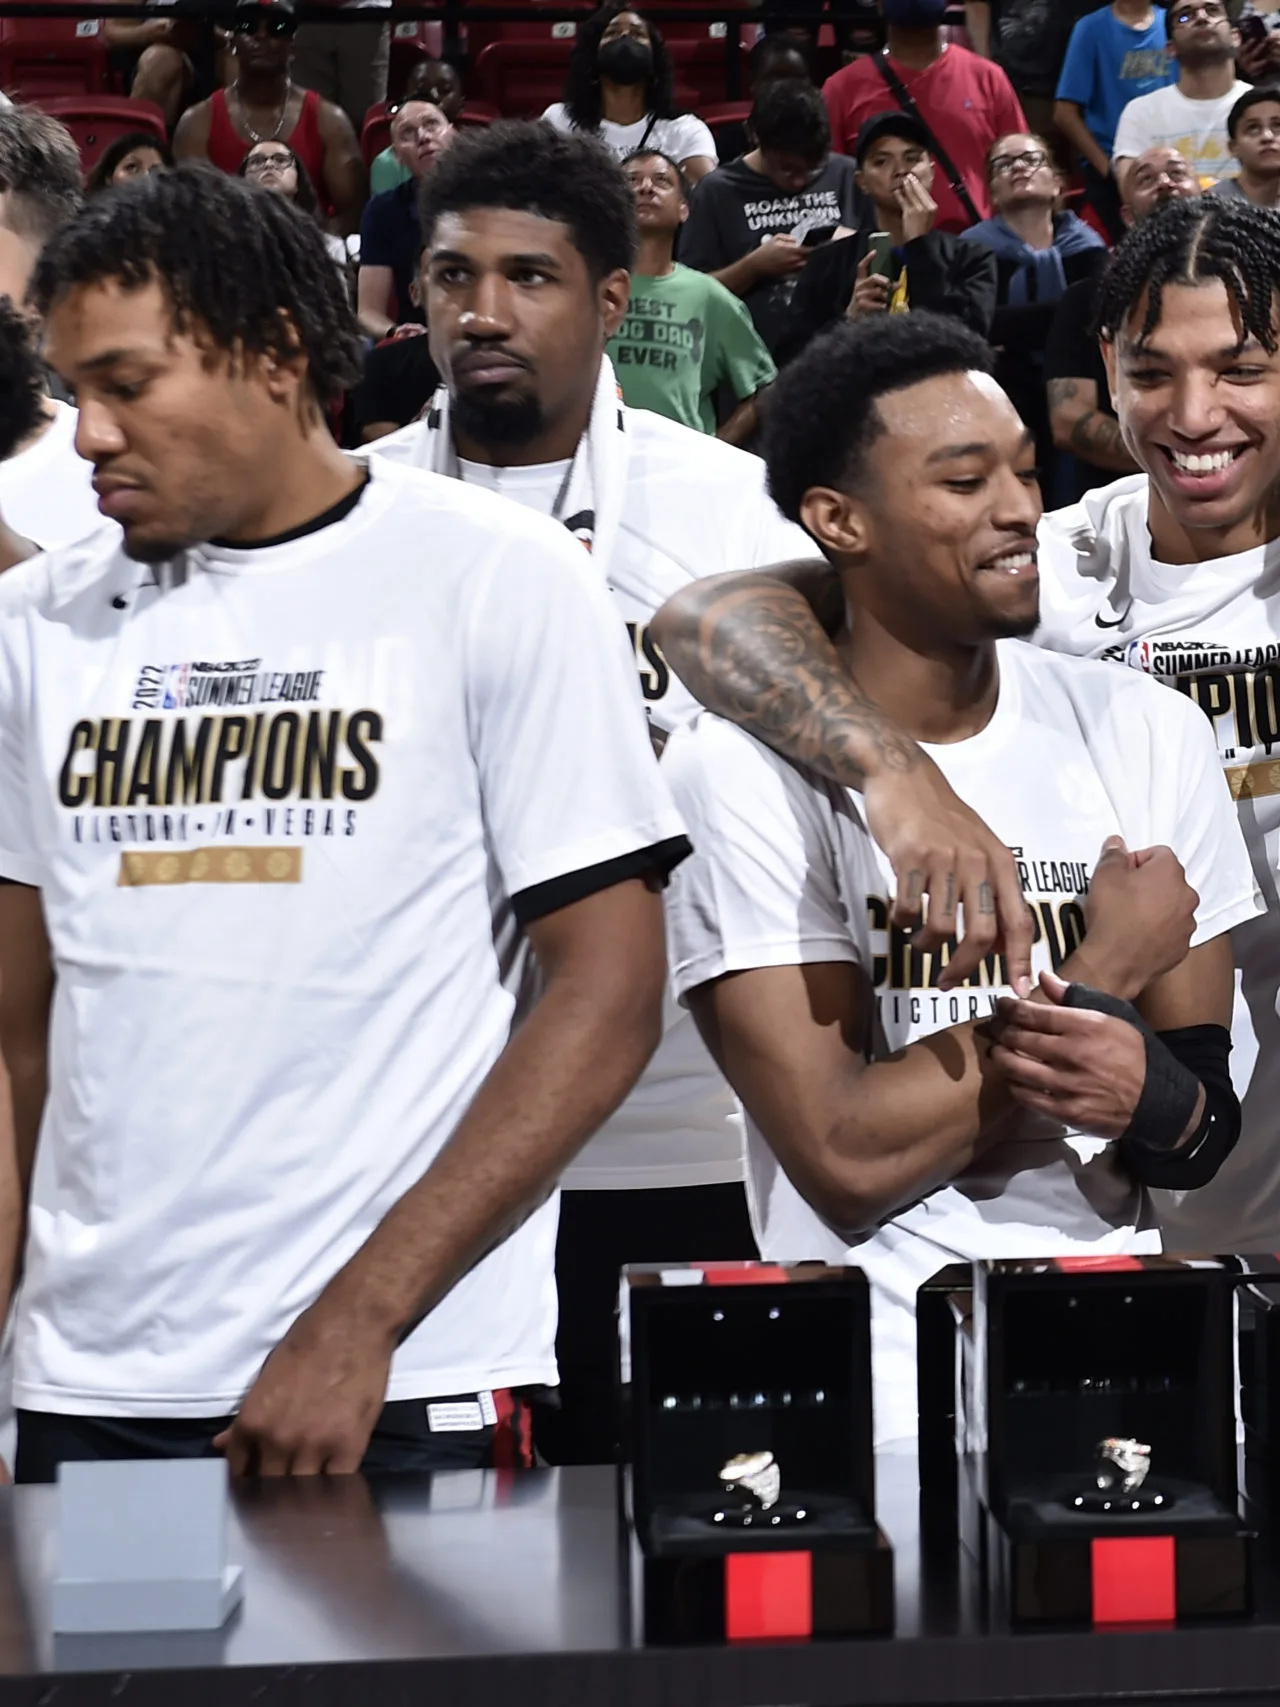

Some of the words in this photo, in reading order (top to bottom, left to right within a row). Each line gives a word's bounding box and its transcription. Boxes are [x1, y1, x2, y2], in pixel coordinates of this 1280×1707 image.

[744, 198, 800, 217] ROAM
[802, 191, 838, 208] THE
[748, 205, 842, 231] UNKNOWN
[614, 320, 646, 341] OG
[653, 321, 694, 349] DAD
[617, 345, 678, 371] EVER
[1153, 651, 1232, 676] SUMMER
[132, 664, 166, 709] 2022
[185, 674, 257, 707] SUMMER
[259, 670, 326, 704] LEAGUE
[57, 708, 383, 808] CHAMPIONS
[262, 806, 358, 837] VEGAS
[1033, 861, 1091, 896] LEAGUE
